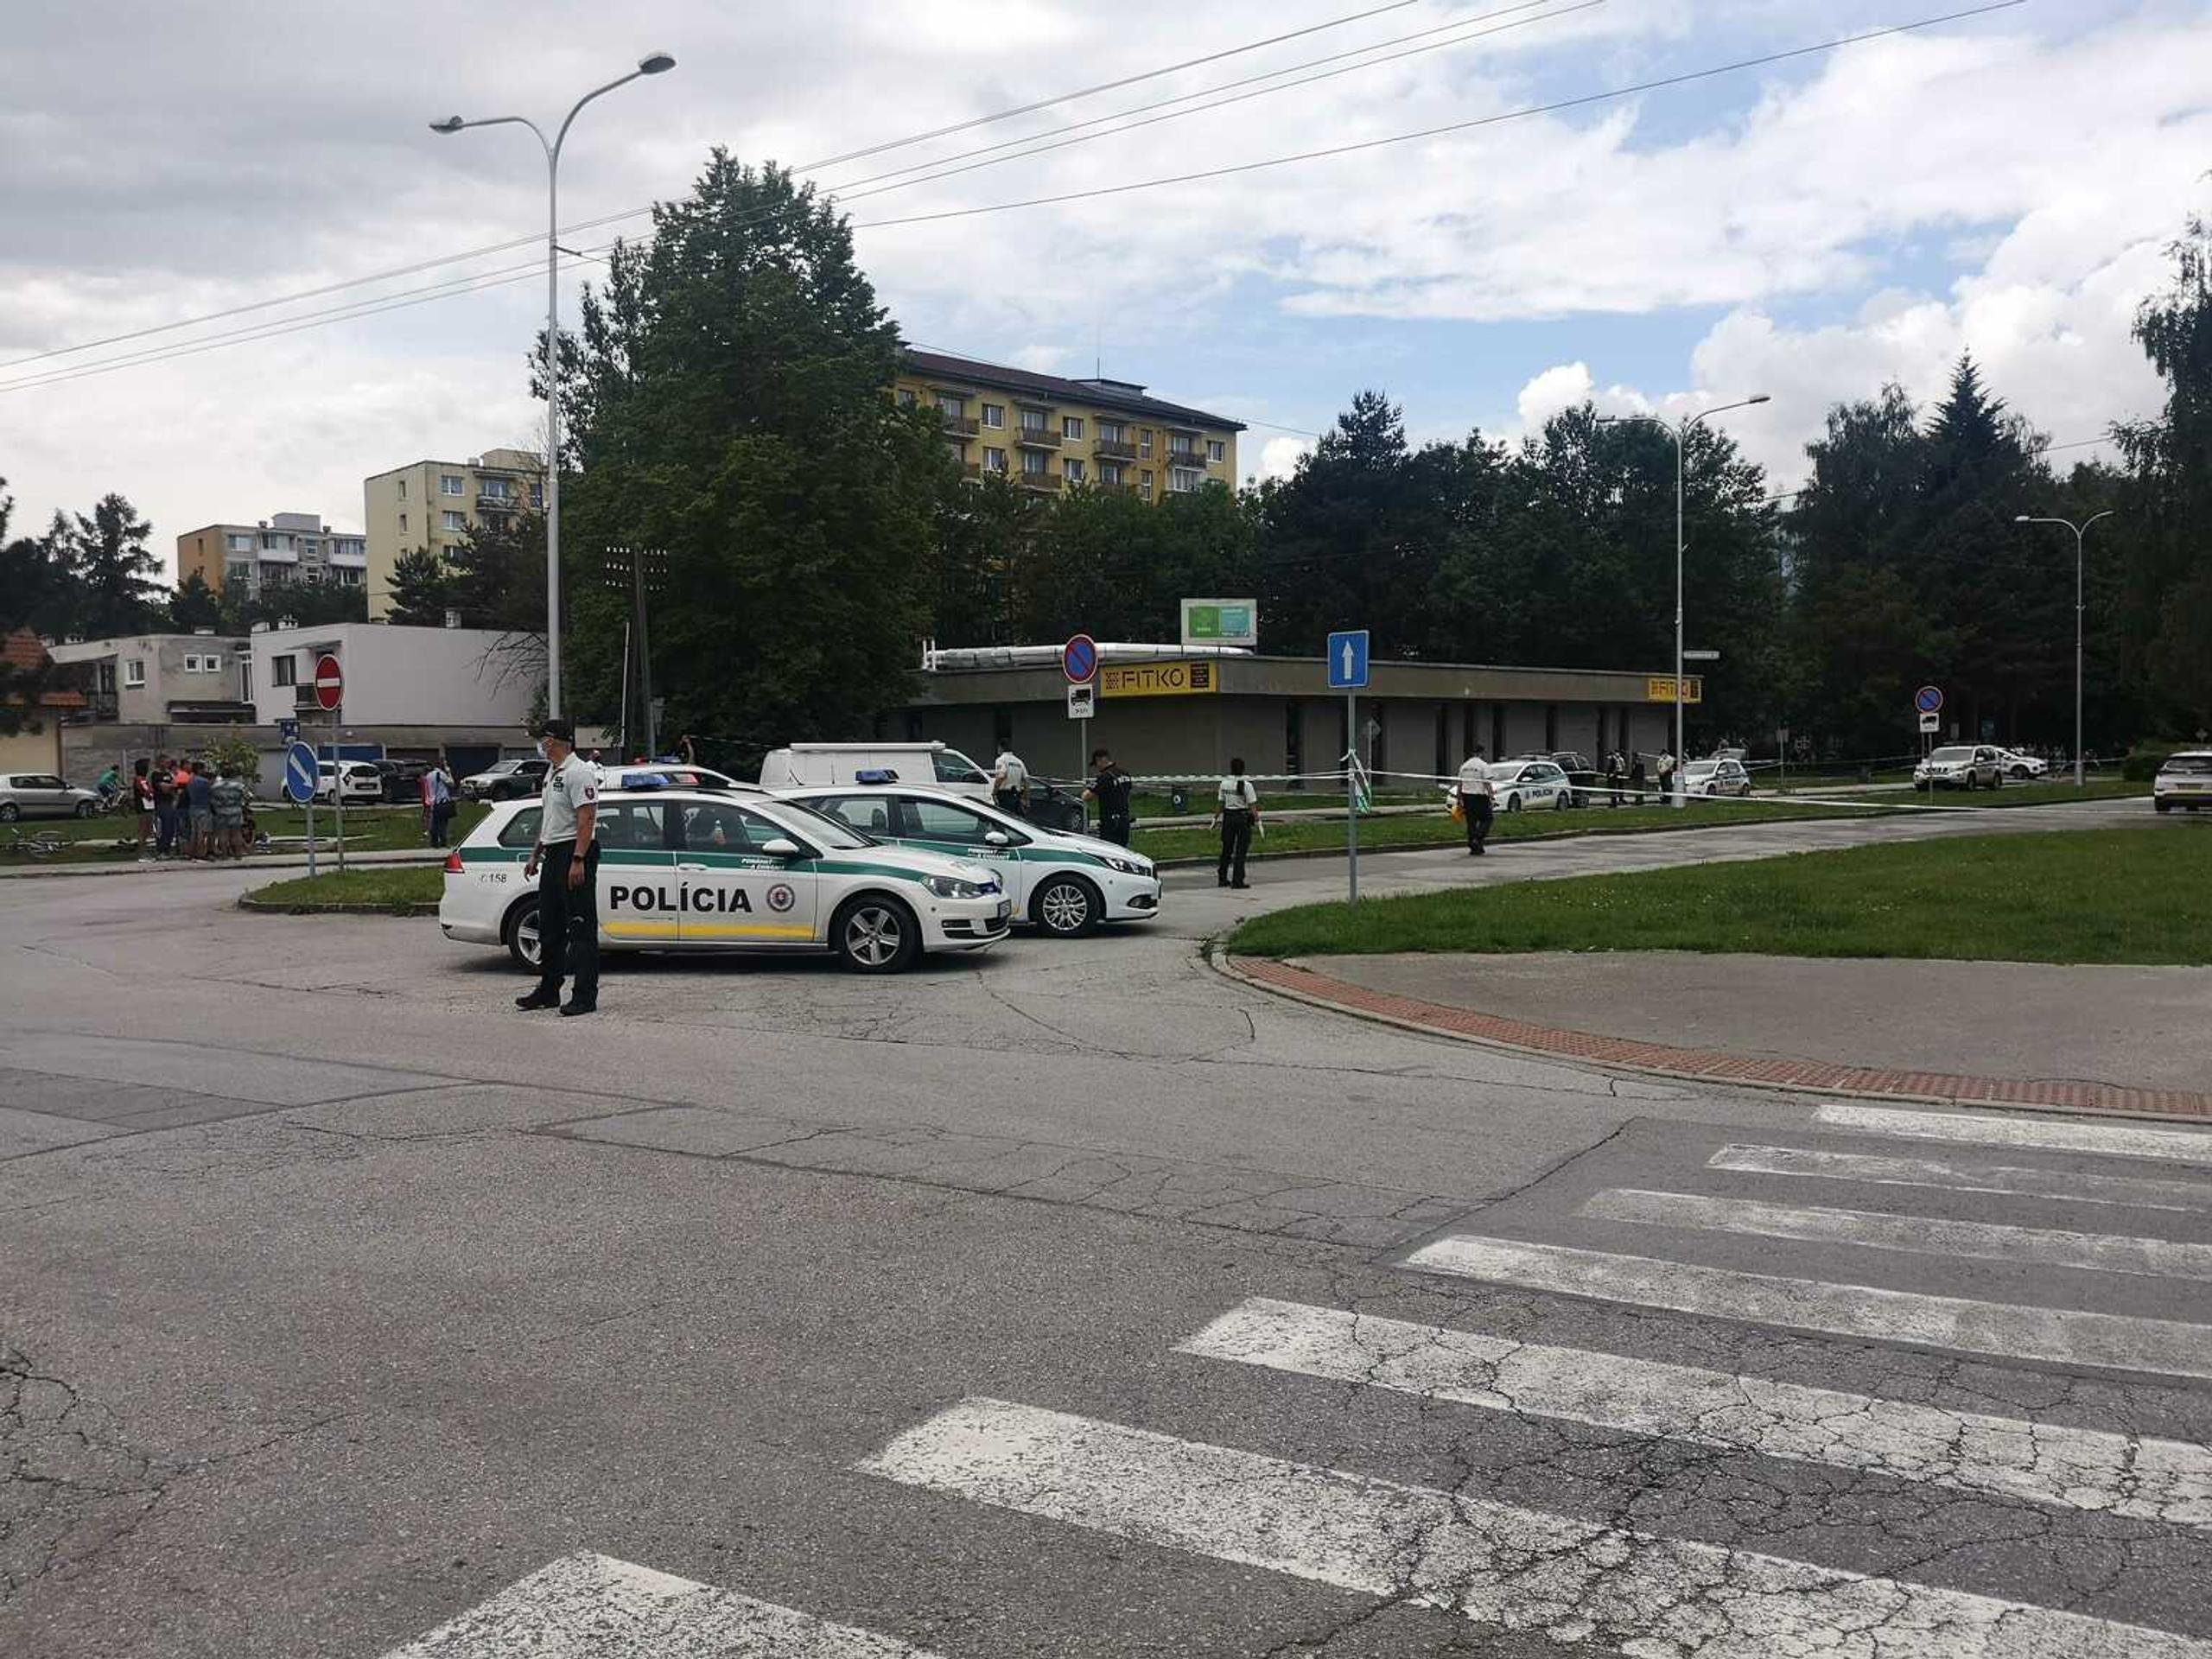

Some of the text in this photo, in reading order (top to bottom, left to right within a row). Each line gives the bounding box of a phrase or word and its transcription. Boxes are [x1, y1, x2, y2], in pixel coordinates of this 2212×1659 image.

[1122, 668, 1184, 689] FITKO
[489, 874, 507, 883] 158
[610, 881, 753, 912] POLÍCIA
